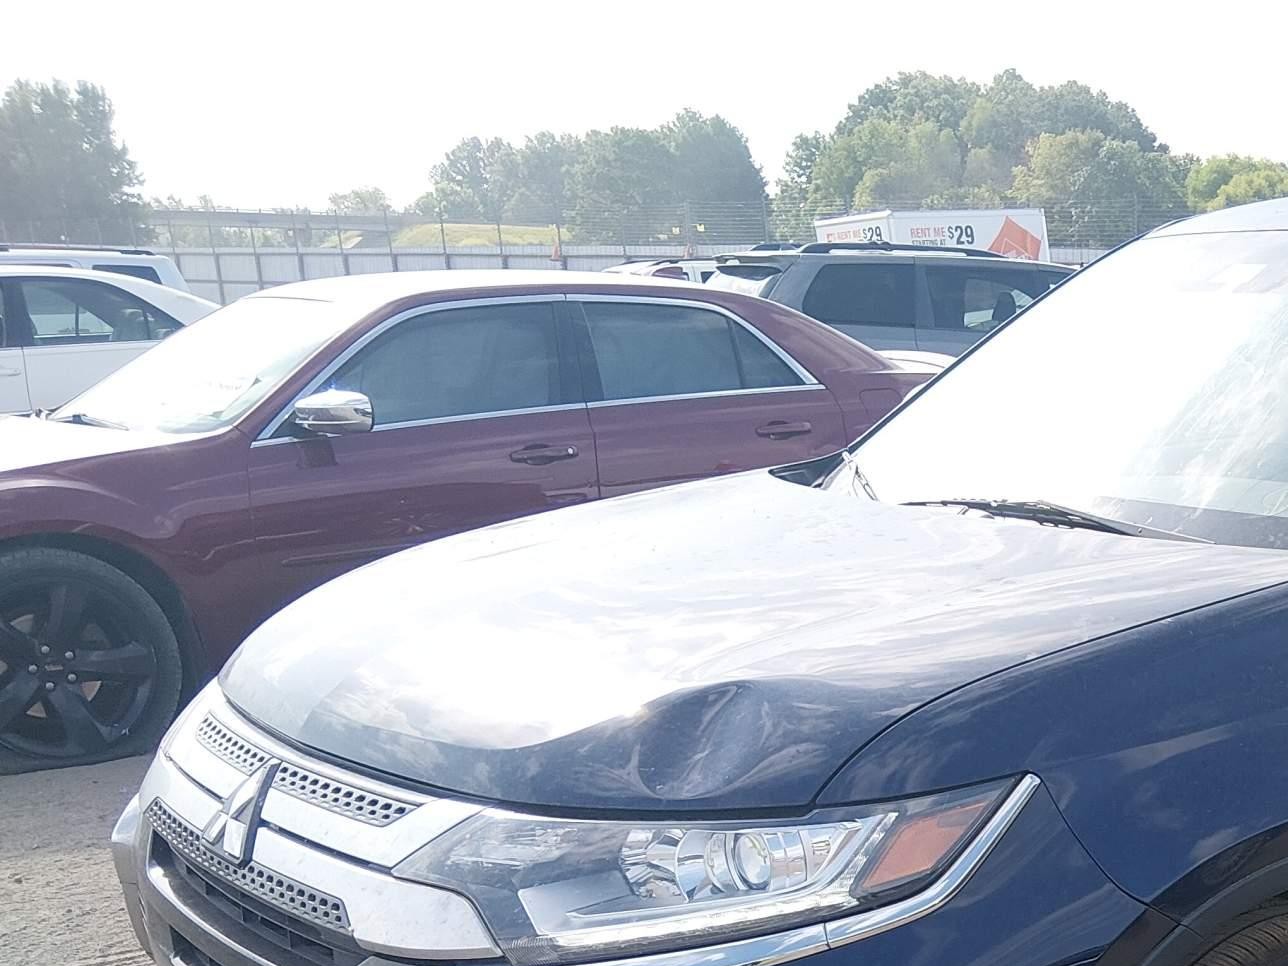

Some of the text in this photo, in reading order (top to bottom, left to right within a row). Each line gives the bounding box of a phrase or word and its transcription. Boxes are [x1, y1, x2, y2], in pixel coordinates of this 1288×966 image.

[863, 226, 884, 242] $29
[911, 225, 975, 245] RENT ME $29
